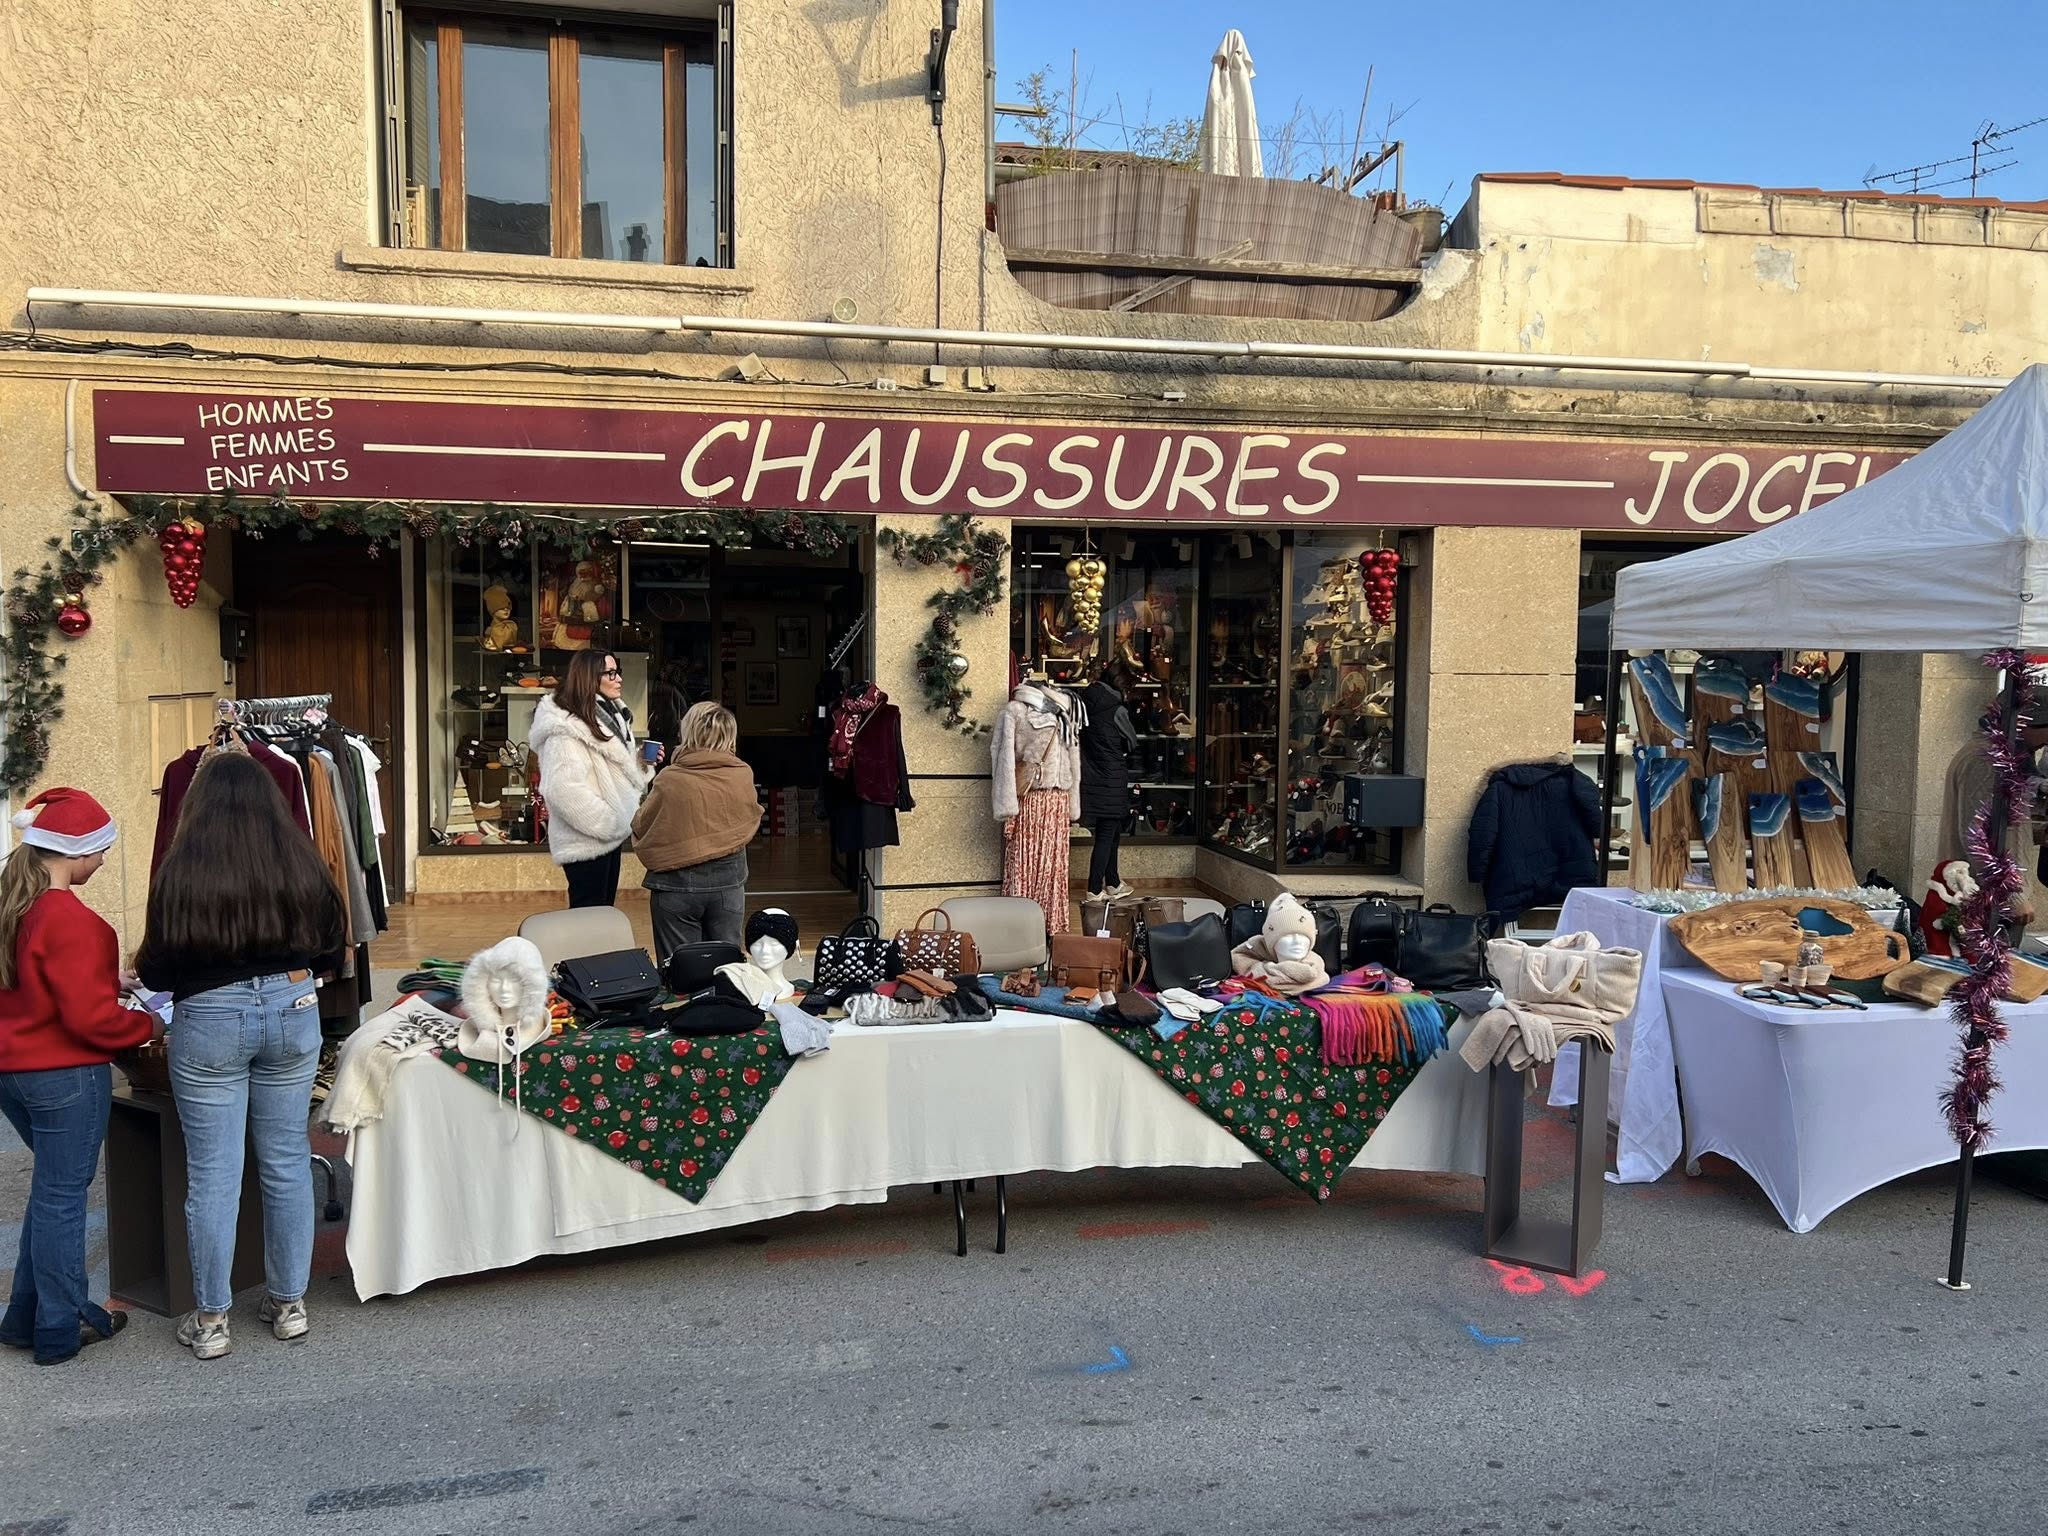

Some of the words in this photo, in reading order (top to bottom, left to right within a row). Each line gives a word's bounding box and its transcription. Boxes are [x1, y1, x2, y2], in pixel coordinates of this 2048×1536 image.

[198, 397, 334, 428] HOMMES
[210, 428, 336, 459] FEMMES
[206, 459, 349, 491] ENFANTS
[680, 418, 1347, 516] CHAUSSURES
[1624, 451, 1909, 525] JOCE
